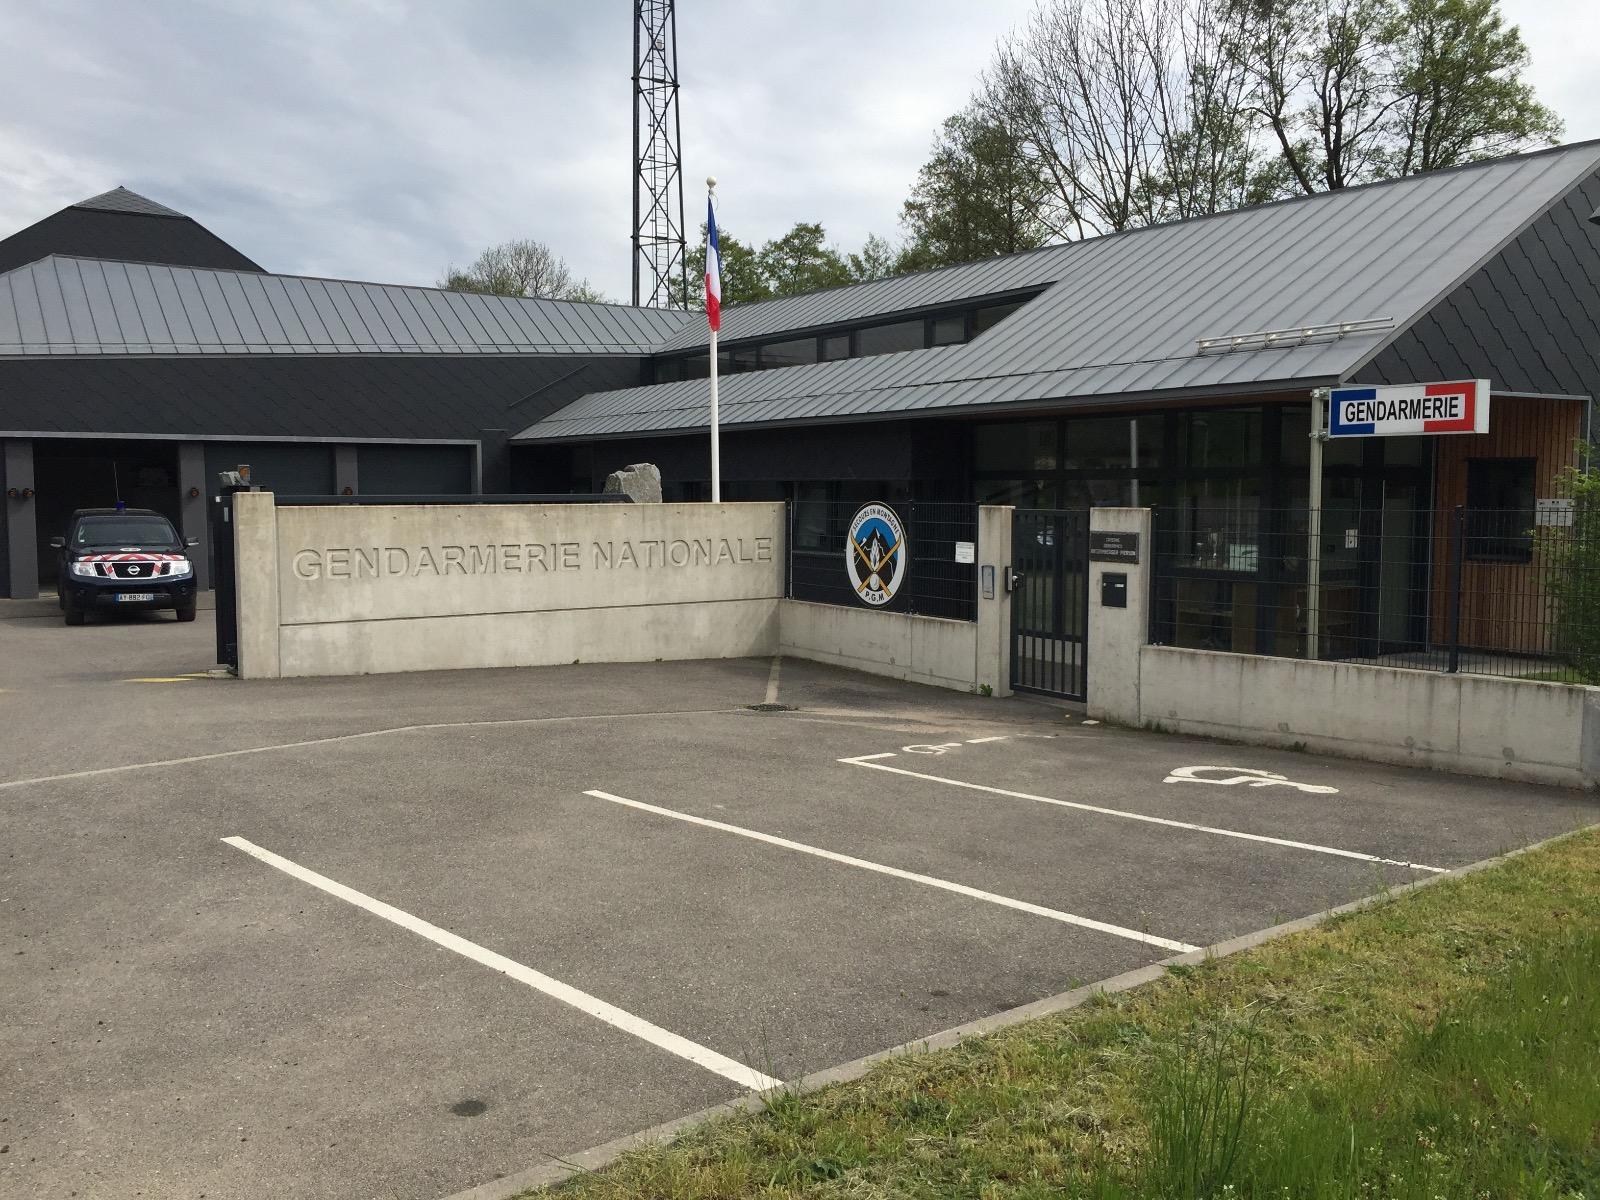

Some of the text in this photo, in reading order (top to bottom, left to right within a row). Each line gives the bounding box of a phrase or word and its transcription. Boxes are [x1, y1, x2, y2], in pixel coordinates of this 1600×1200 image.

[1345, 396, 1459, 422] GENDARMERIE
[292, 537, 772, 581] GENDARMERIE NATIONALE
